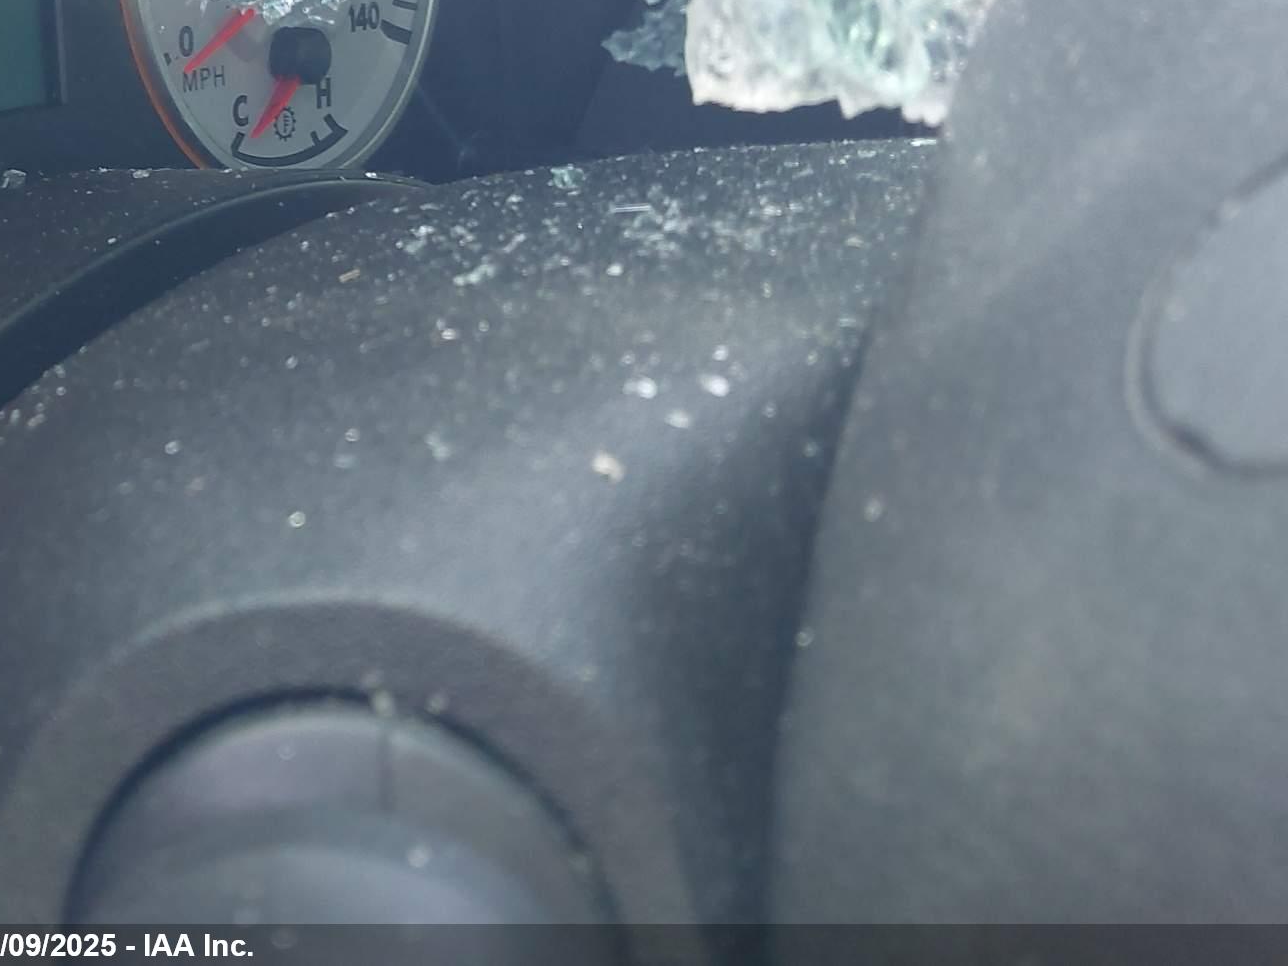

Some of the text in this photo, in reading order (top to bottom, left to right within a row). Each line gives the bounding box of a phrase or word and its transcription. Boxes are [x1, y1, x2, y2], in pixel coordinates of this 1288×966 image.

[349, 2, 380, 32] 140
[179, 26, 194, 57] 0
[183, 66, 226, 93] MPH
[317, 78, 331, 109] H
[232, 95, 249, 126] C
